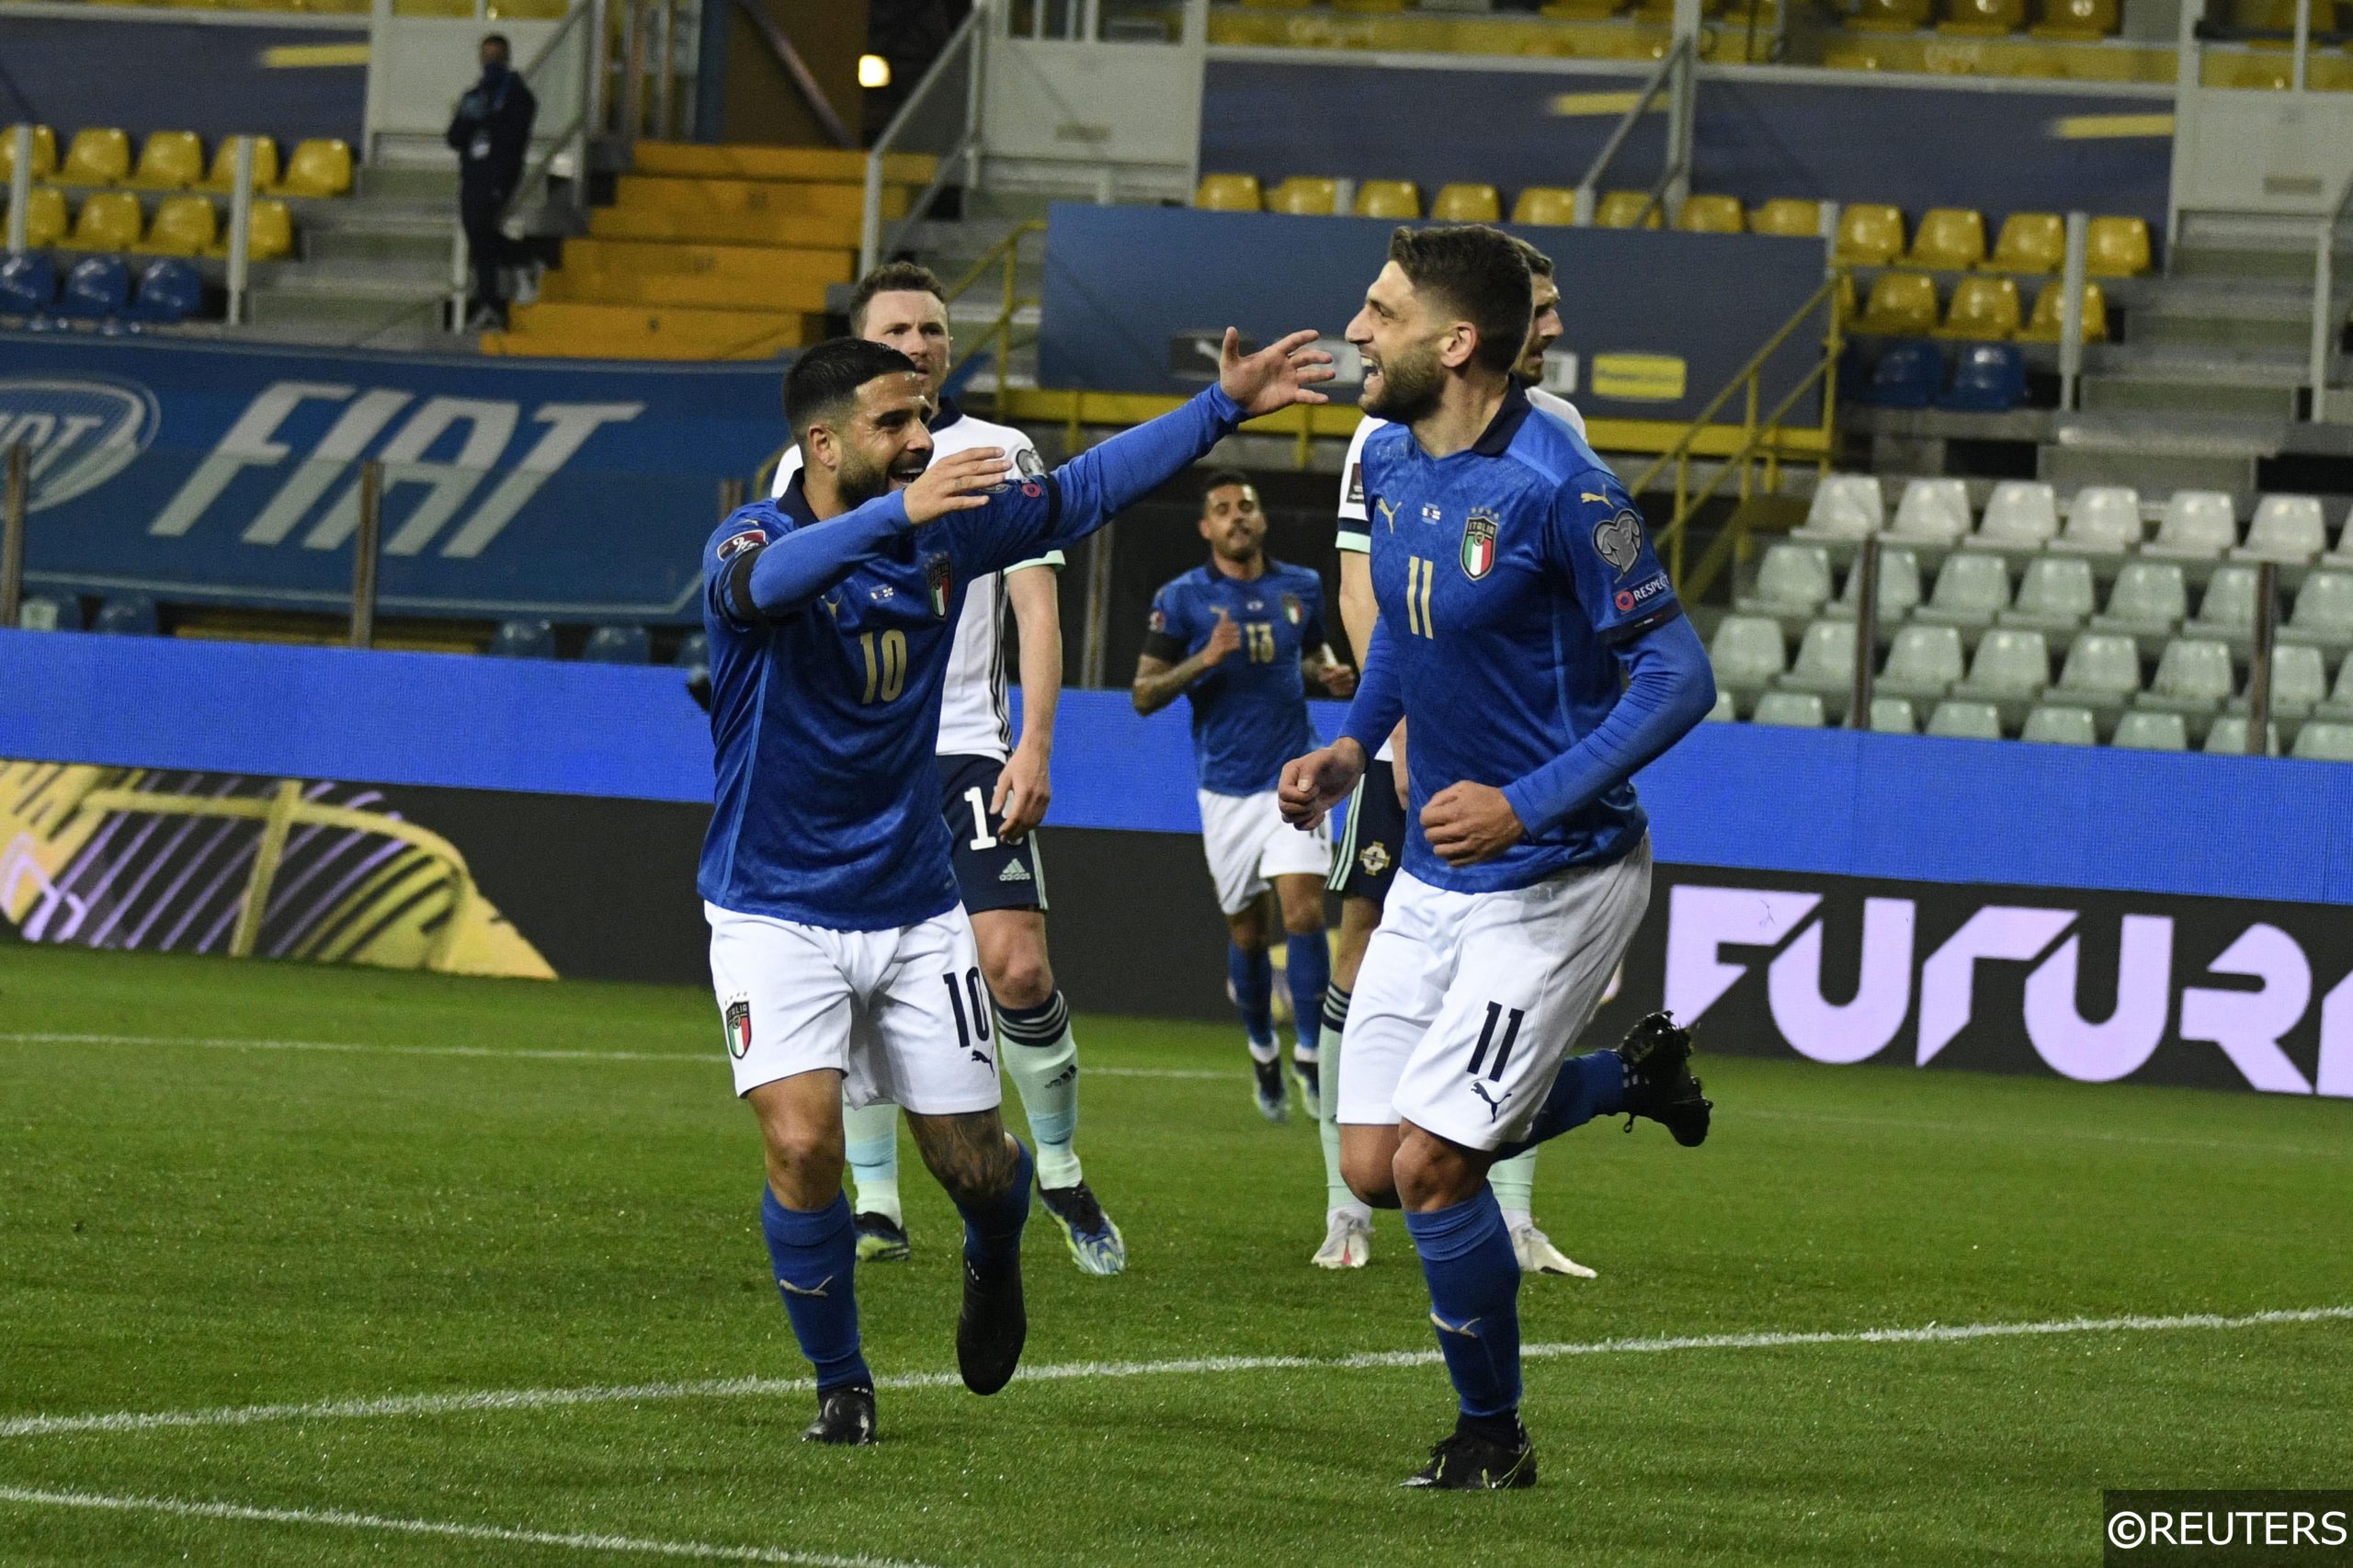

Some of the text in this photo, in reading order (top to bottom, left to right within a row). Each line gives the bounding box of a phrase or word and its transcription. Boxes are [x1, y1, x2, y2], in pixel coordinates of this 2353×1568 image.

[148, 380, 647, 559] FIAT
[1406, 555, 1434, 640] 11
[1632, 574, 1670, 601] RESPECT
[859, 629, 907, 705] 10
[998, 872, 1031, 881] adidas
[943, 966, 990, 1048] 10
[1467, 1001, 1526, 1083] 11
